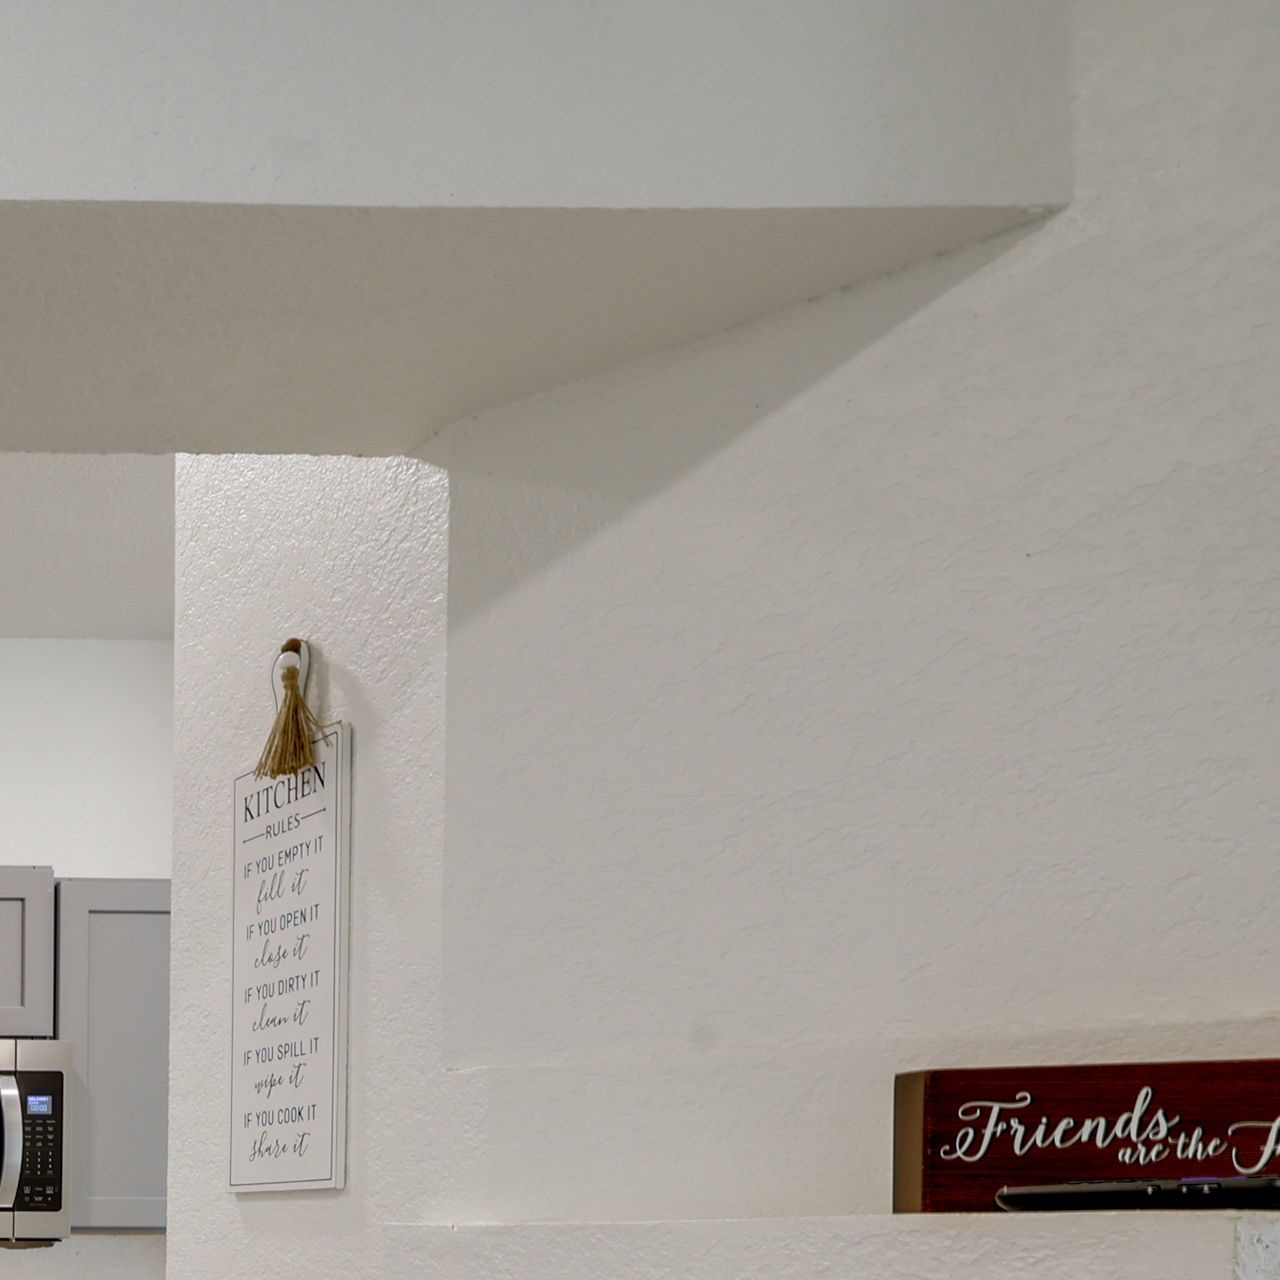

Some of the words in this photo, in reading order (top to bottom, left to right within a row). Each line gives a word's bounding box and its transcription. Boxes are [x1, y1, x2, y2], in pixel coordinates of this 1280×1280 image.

[243, 761, 326, 823] KITCHEN
[265, 816, 300, 840] RULES
[244, 864, 254, 879] IF
[256, 854, 274, 873] YOU
[278, 841, 311, 868] EMPTY
[314, 835, 323, 852] IT
[257, 870, 286, 914] fill
[291, 868, 309, 896] it
[246, 924, 255, 941] IF
[258, 917, 277, 936] YOU
[280, 908, 307, 931] OPEN
[310, 903, 320, 921] IT
[254, 938, 289, 969] close
[293, 934, 310, 960] it
[244, 987, 253, 1004] IF
[256, 982, 275, 1000] YOU
[278, 973, 308, 996] DIRTY
[310, 970, 320, 988] IT
[252, 1003, 289, 1032] clean
[293, 1000, 311, 1026] it
[243, 1050, 253, 1066] IF
[255, 1046, 274, 1064] YOU
[277, 1041, 306, 1061] SPILL
[310, 1037, 319, 1054] IT
[255, 1073, 284, 1099] wipe
[289, 1063, 307, 1088] it
[244, 1112, 253, 1128] IF
[255, 1110, 274, 1127] YOU
[277, 1106, 304, 1125] COOK
[307, 1104, 317, 1121] IT
[940, 1086, 1180, 1163] Friends
[1118, 1142, 1171, 1166] are
[1168, 1125, 1228, 1161] the
[249, 1130, 289, 1162] share
[293, 1132, 311, 1157] it
